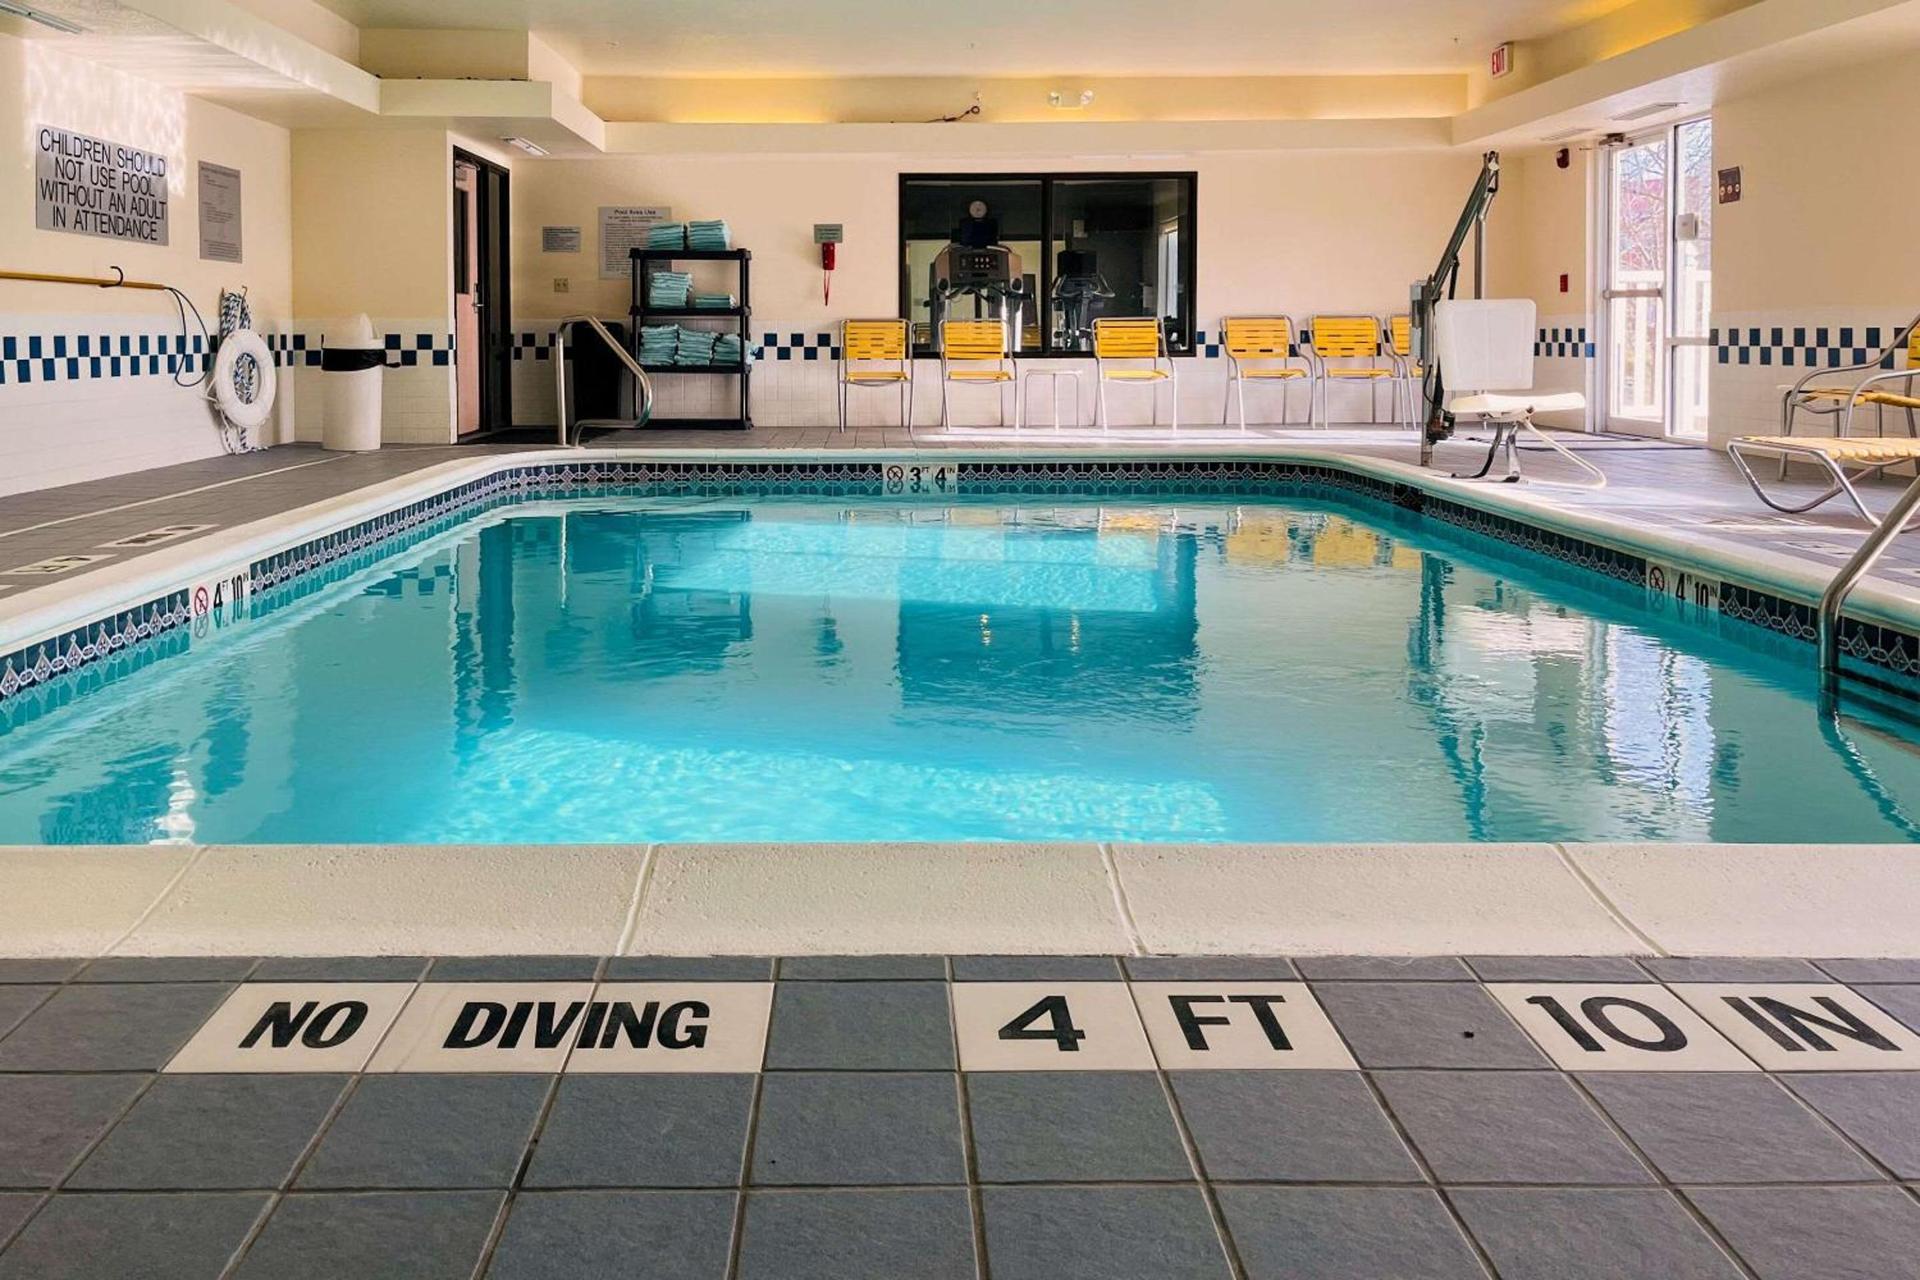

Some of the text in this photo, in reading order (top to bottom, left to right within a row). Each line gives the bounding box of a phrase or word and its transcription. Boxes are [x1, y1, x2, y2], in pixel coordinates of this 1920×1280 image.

[40, 128, 166, 178] CHILDREN SHOULD
[55, 156, 155, 198] NOT USE POOL
[40, 178, 167, 220] WITHOUT AN ADULT
[53, 205, 157, 241] IN ATTENDANCE
[910, 467, 921, 481] 3
[935, 467, 946, 481] 4
[214, 582, 223, 608] 4
[231, 574, 244, 601] 10
[1676, 572, 1686, 600] 4
[1695, 581, 1709, 608] 10
[237, 995, 1903, 1052] NO DIVING 4 FT 10 IN
